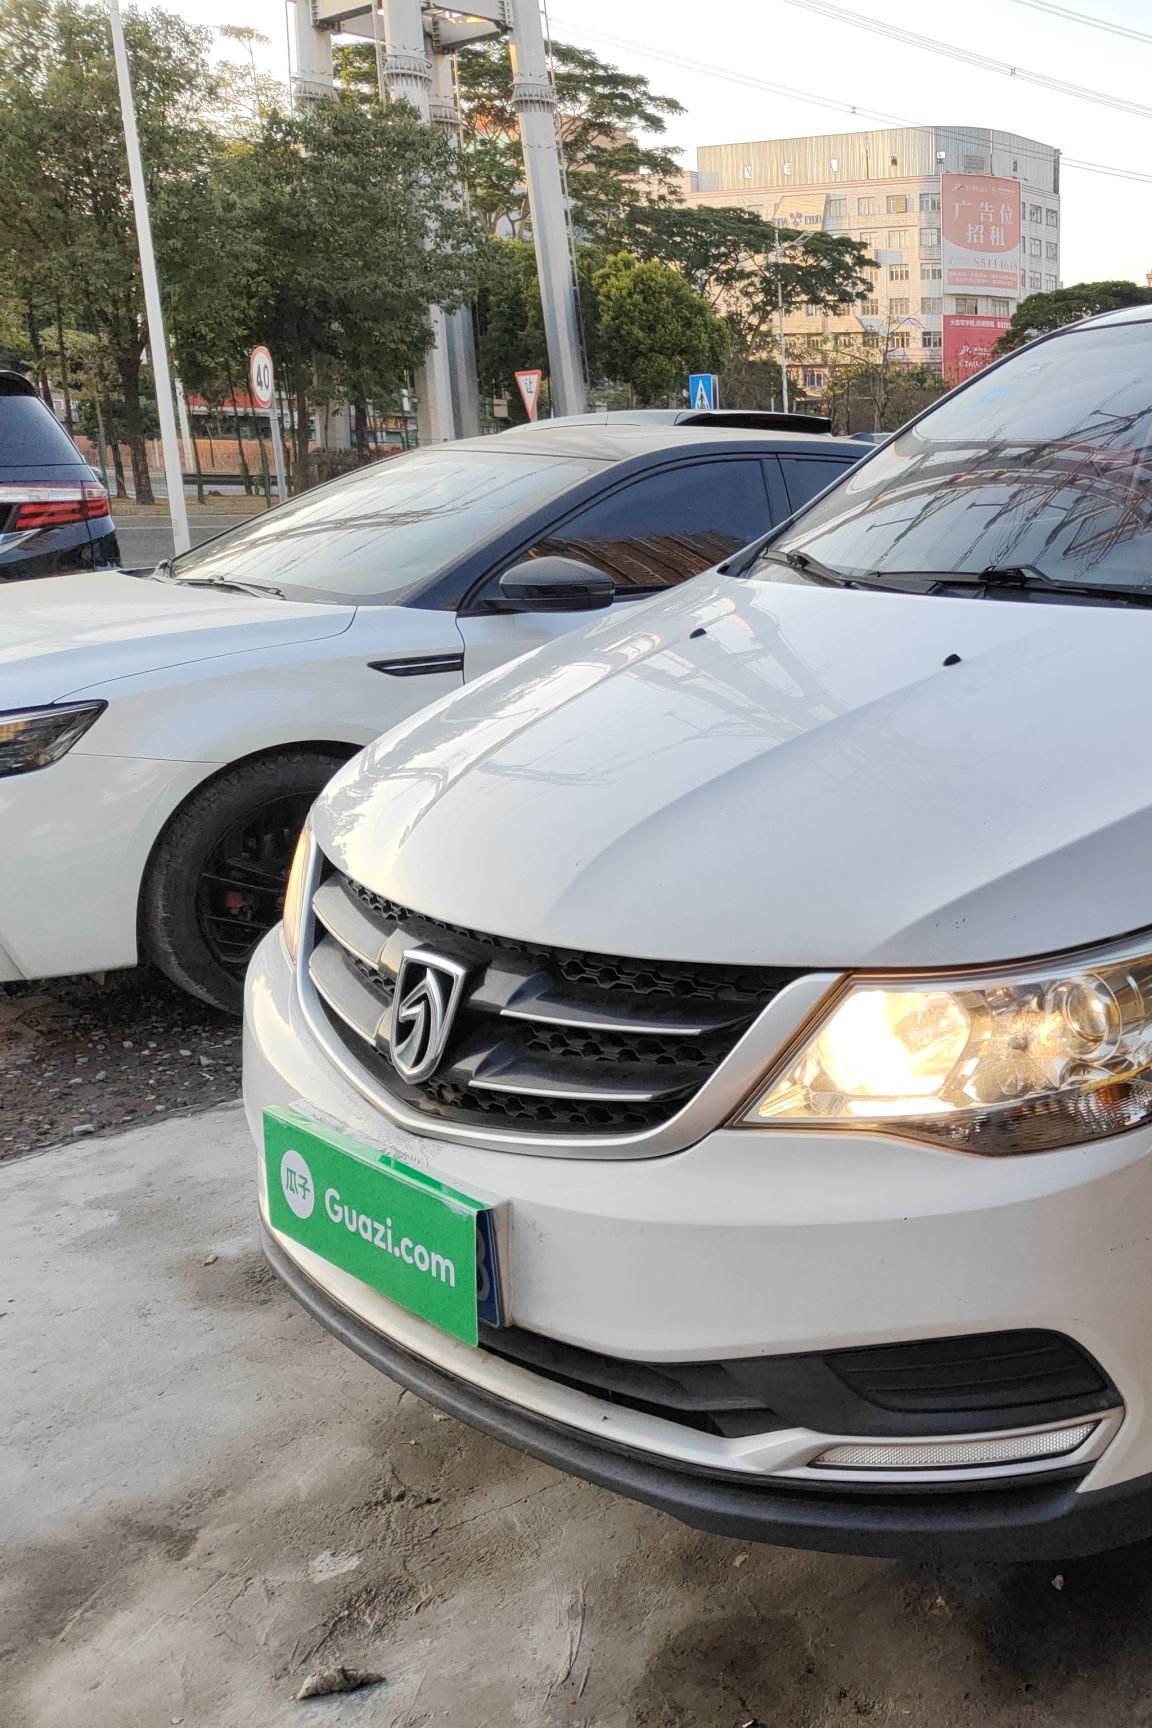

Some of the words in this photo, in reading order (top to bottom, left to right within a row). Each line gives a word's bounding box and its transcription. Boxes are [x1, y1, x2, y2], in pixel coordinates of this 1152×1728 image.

[953, 200, 1013, 224] 广告位
[966, 223, 1005, 246] 招租
[256, 364, 270, 391] 40
[525, 377, 534, 394] 让
[285, 1167, 311, 1200] 瓜子
[324, 1188, 456, 1288] Guazi.com
